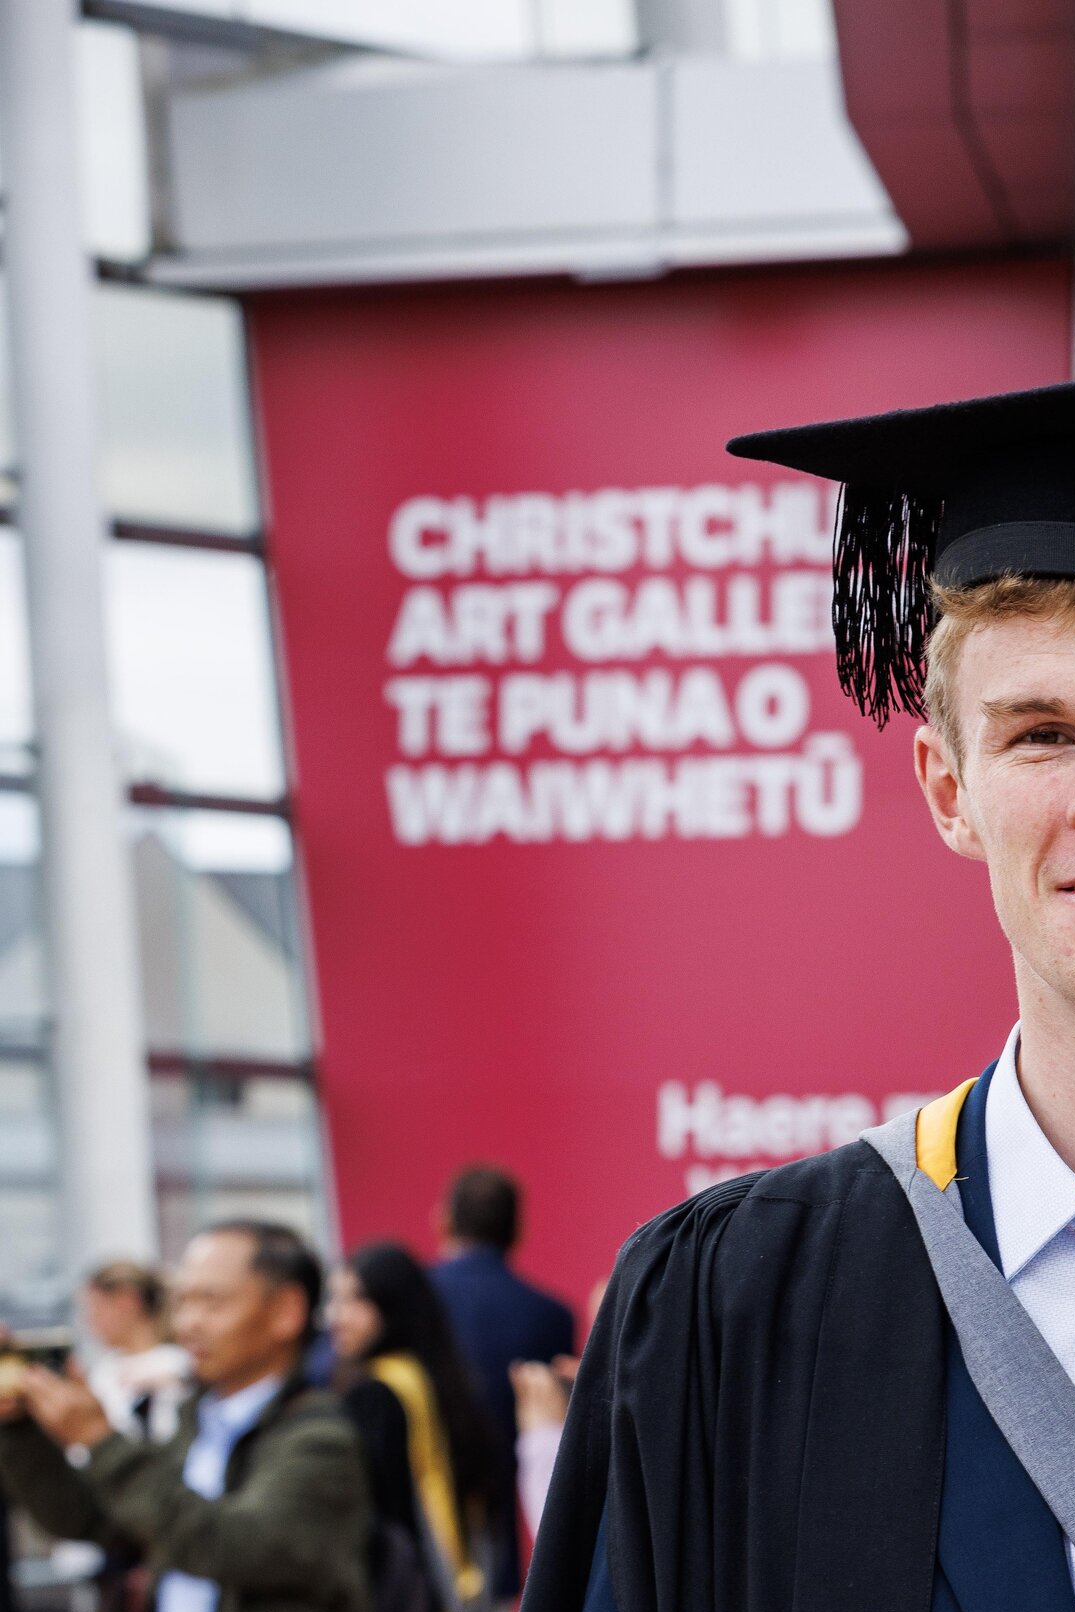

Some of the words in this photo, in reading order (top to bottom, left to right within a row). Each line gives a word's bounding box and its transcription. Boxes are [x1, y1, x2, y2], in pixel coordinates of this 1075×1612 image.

[389, 484, 842, 578] CHRISTCHU
[388, 584, 556, 665] ART
[562, 571, 836, 661] GALLE
[386, 675, 490, 756] TE
[500, 666, 732, 753] PUNA
[736, 664, 810, 748] O
[657, 1081, 873, 1159] Haere
